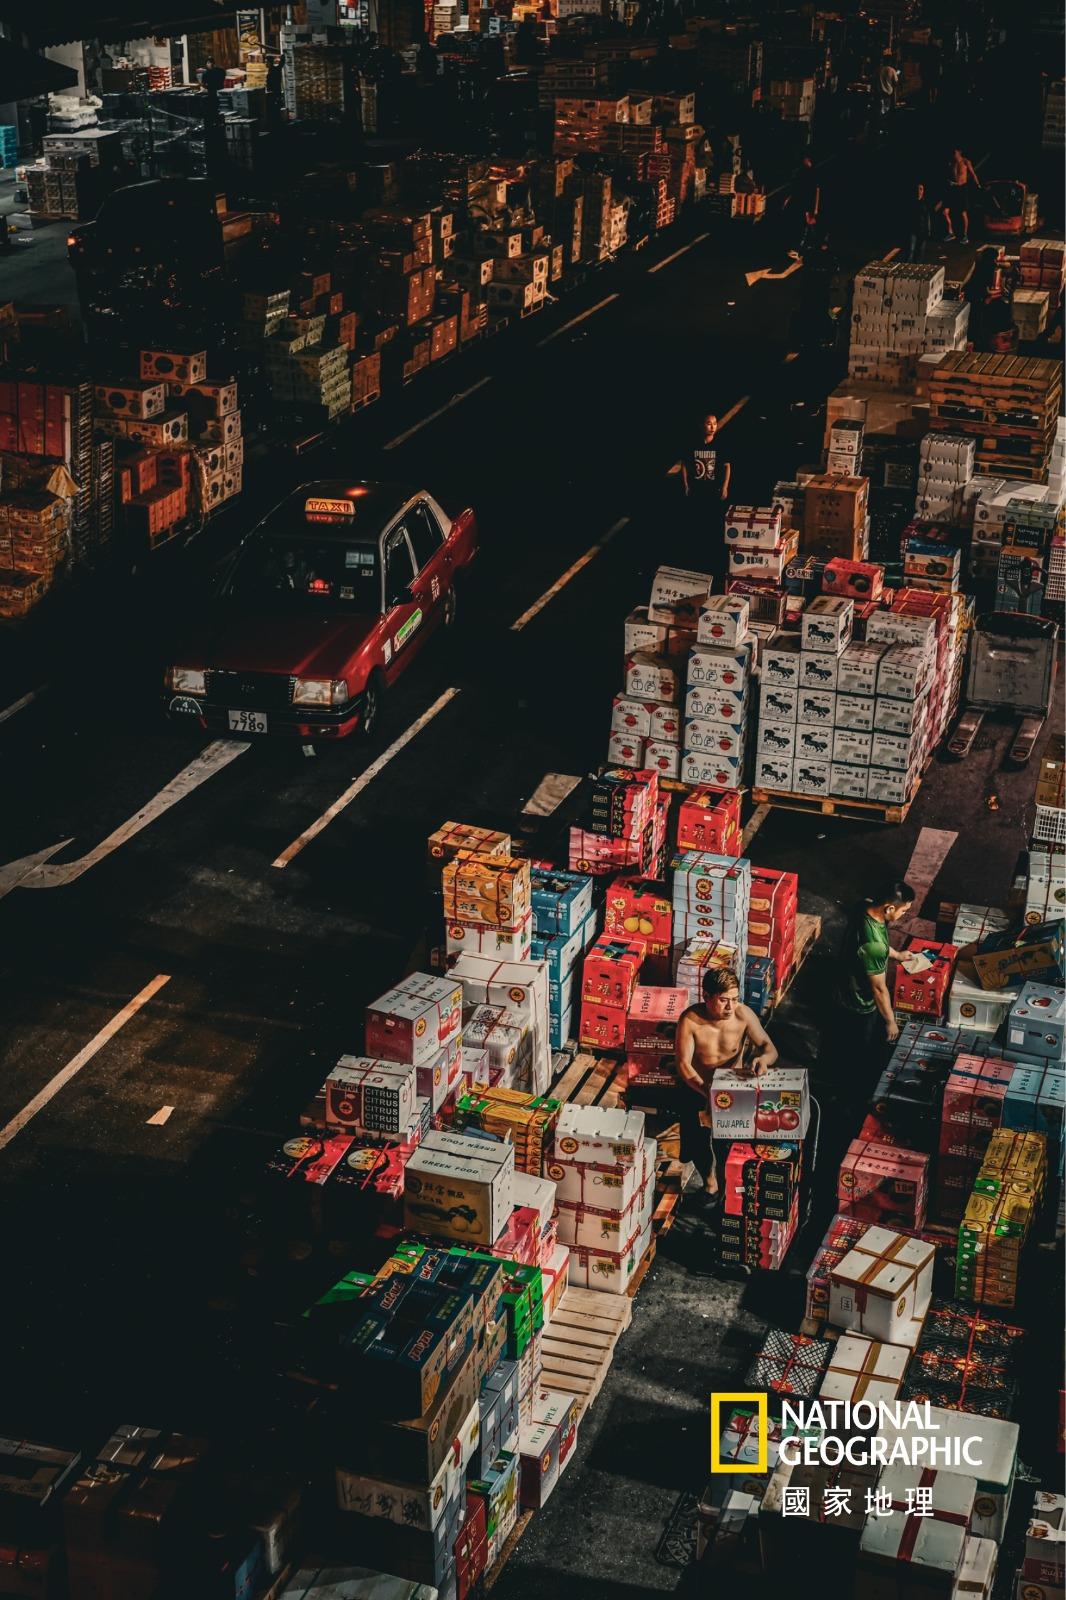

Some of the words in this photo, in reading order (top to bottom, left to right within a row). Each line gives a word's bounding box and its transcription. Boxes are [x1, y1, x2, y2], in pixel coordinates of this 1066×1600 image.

[308, 501, 350, 511] TAXI
[240, 712, 256, 721] SG
[231, 720, 265, 731] 7789
[365, 1088, 398, 1098] CITRUS
[365, 1096, 398, 1107] CITRUS
[365, 1105, 398, 1115] CITRUS
[365, 1113, 398, 1124] CITRUS
[365, 1121, 398, 1132] CITRUS
[717, 1119, 731, 1129] FUJI
[731, 1119, 749, 1128] APPLE
[422, 1160, 452, 1169] GREEN
[454, 1166, 479, 1175] FOOD
